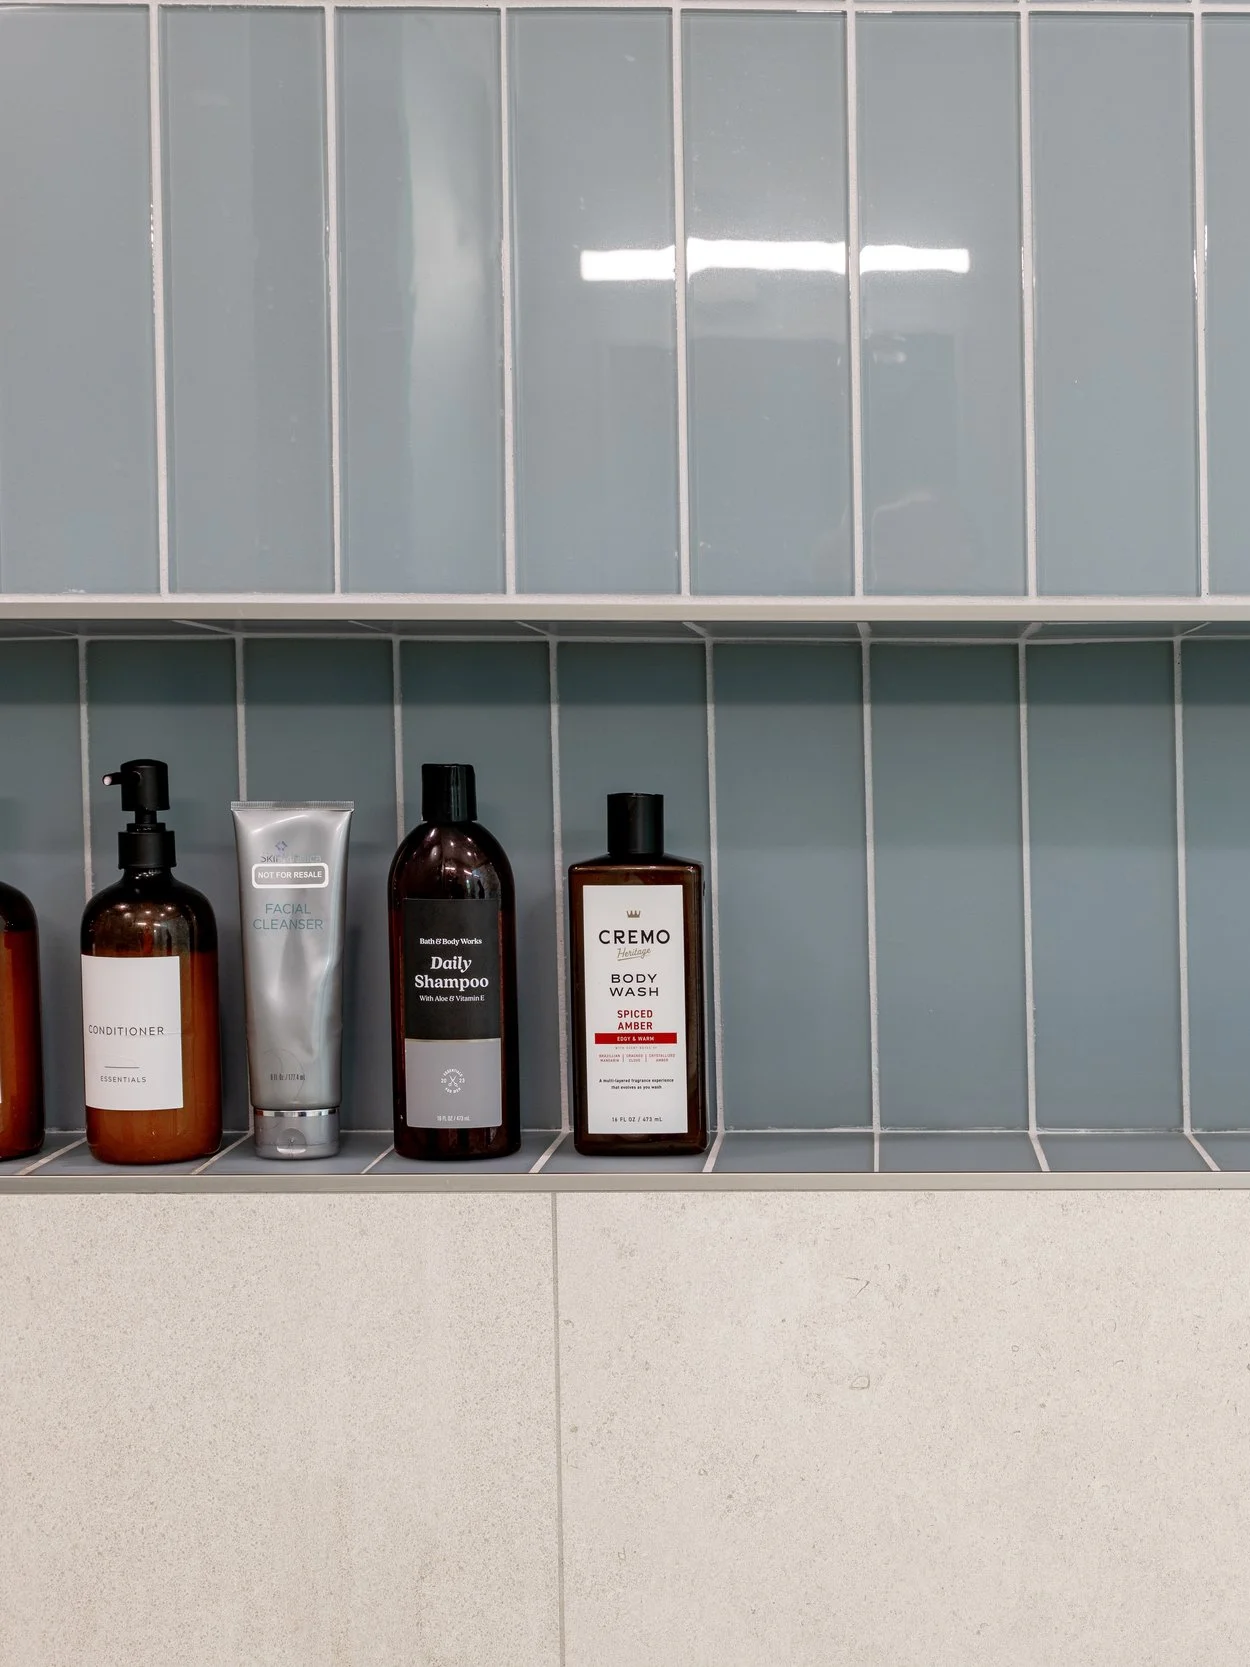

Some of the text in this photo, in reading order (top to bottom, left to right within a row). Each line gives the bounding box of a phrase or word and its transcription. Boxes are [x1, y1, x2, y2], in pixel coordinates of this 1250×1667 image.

[265, 904, 311, 914] FACIAL
[253, 919, 323, 929] CLEANSER
[599, 930, 670, 944] CREMO
[617, 947, 651, 959] Heritage
[430, 956, 472, 973] Daily
[415, 975, 489, 991] Shampoo
[611, 974, 657, 983] BODY
[609, 987, 658, 996] WASH
[617, 1010, 653, 1018] SPICED
[88, 1025, 164, 1036] CONDITIONER
[618, 1022, 653, 1030] AMBER
